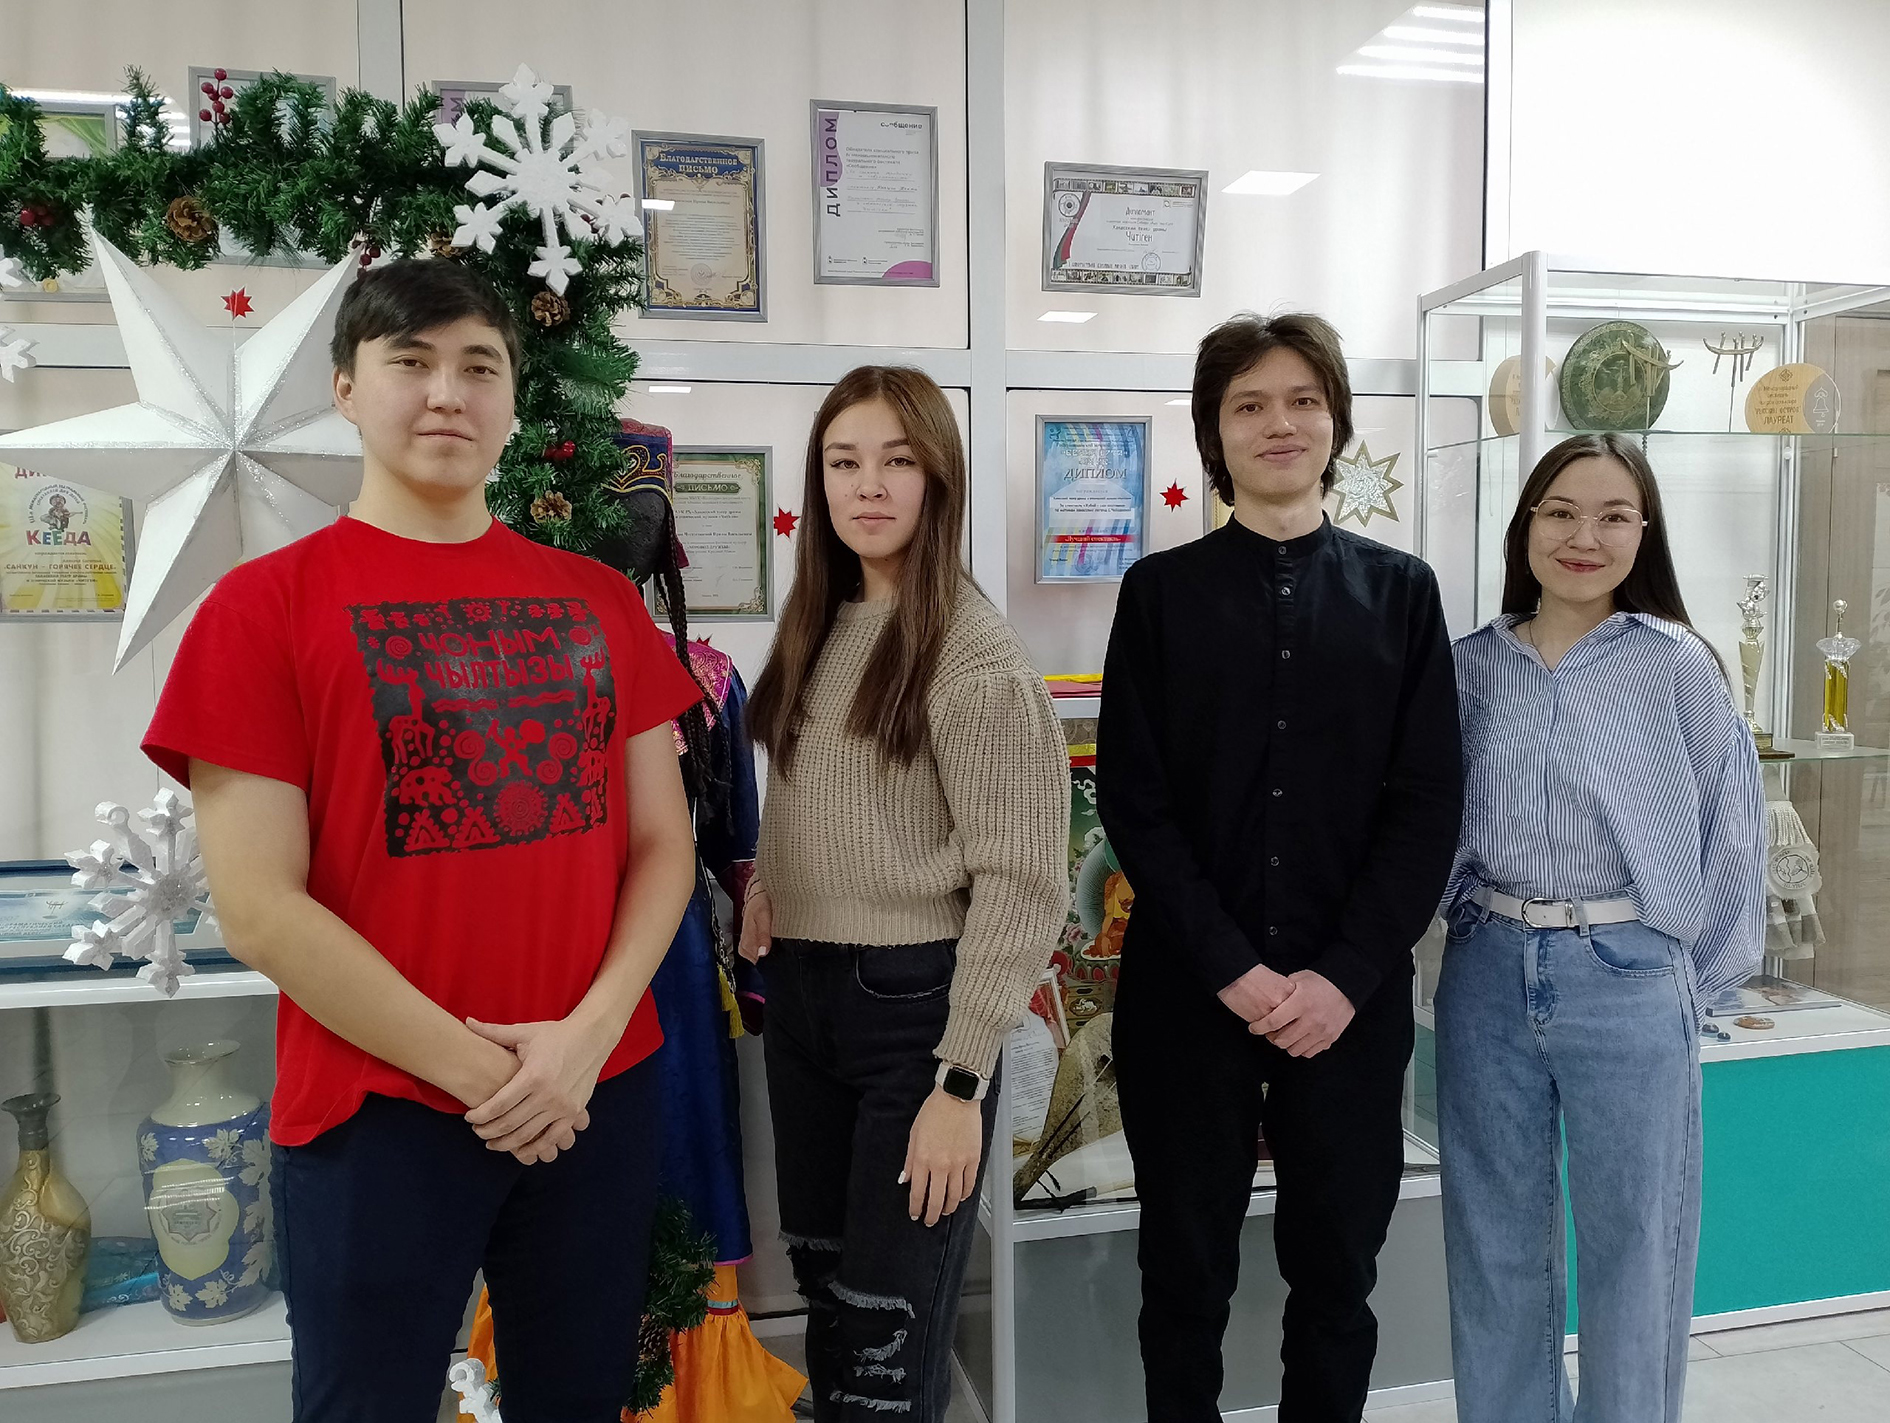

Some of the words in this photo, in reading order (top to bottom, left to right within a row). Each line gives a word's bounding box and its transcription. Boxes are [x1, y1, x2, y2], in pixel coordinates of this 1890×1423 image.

[678, 164, 718, 174] ПИСЬМО
[825, 118, 841, 217] ДИПЛОМ
[1763, 415, 1794, 425] ЛАУРЕАТ
[1063, 468, 1127, 481] ДИПЛОМ
[687, 483, 729, 492] ПИСЬМО
[26, 529, 91, 546] КЕЕДА
[417, 626, 562, 658] ЧОНЫМ
[423, 653, 575, 690] ЧЫЛТЫЗЫ
